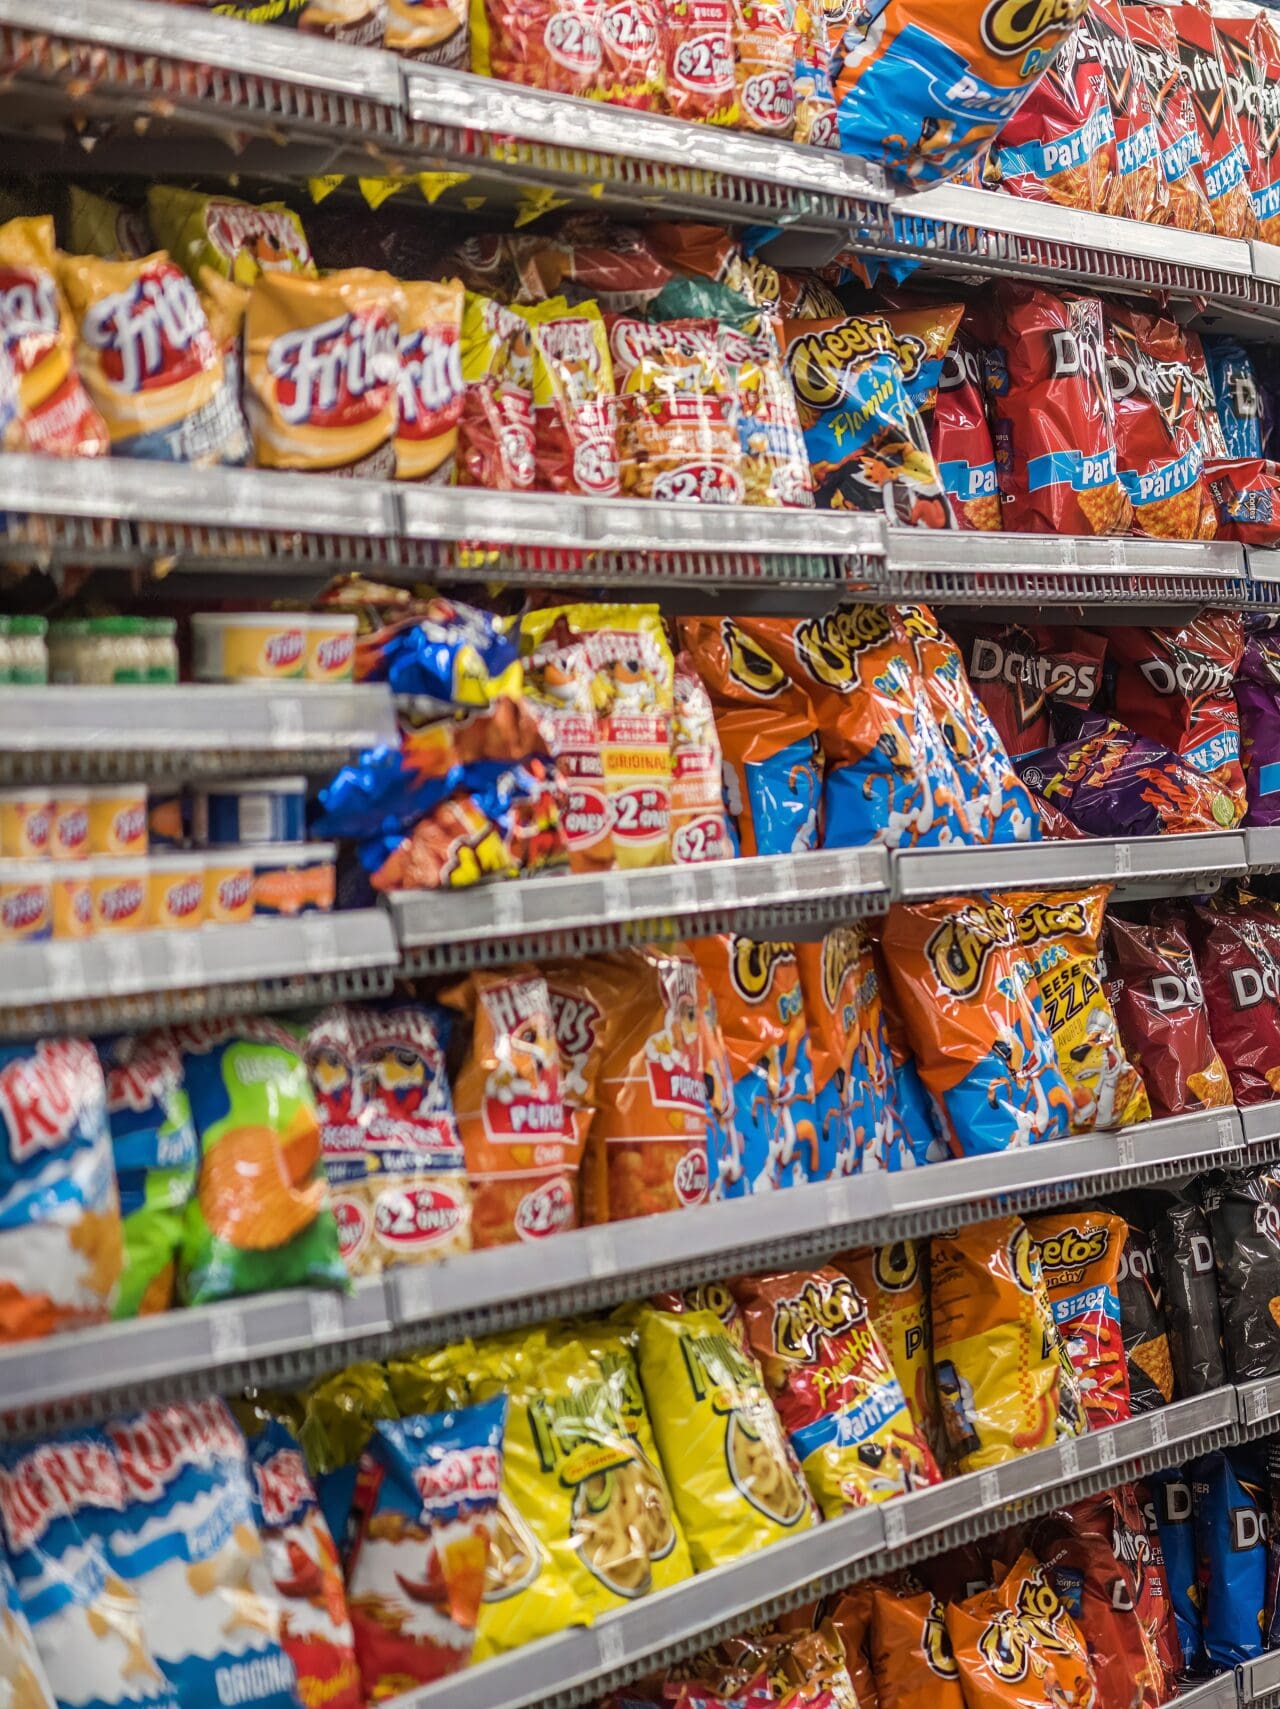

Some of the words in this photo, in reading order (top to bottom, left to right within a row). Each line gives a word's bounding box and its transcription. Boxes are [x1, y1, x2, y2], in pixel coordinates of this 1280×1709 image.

[266, 312, 400, 425] Frito
[788, 317, 924, 406] Cheetos
[828, 374, 894, 448] Flamin
[1140, 462, 1189, 500] Party
[1209, 481, 1225, 505] Doritos
[1248, 491, 1258, 521] Doritos
[969, 638, 1098, 699] Doritos
[1016, 903, 1086, 942] etos
[1041, 963, 1081, 997] EESE
[1044, 973, 1100, 1035] ZZA
[1057, 1018, 1083, 1048] AVORED
[1035, 1230, 1110, 1268] eetos
